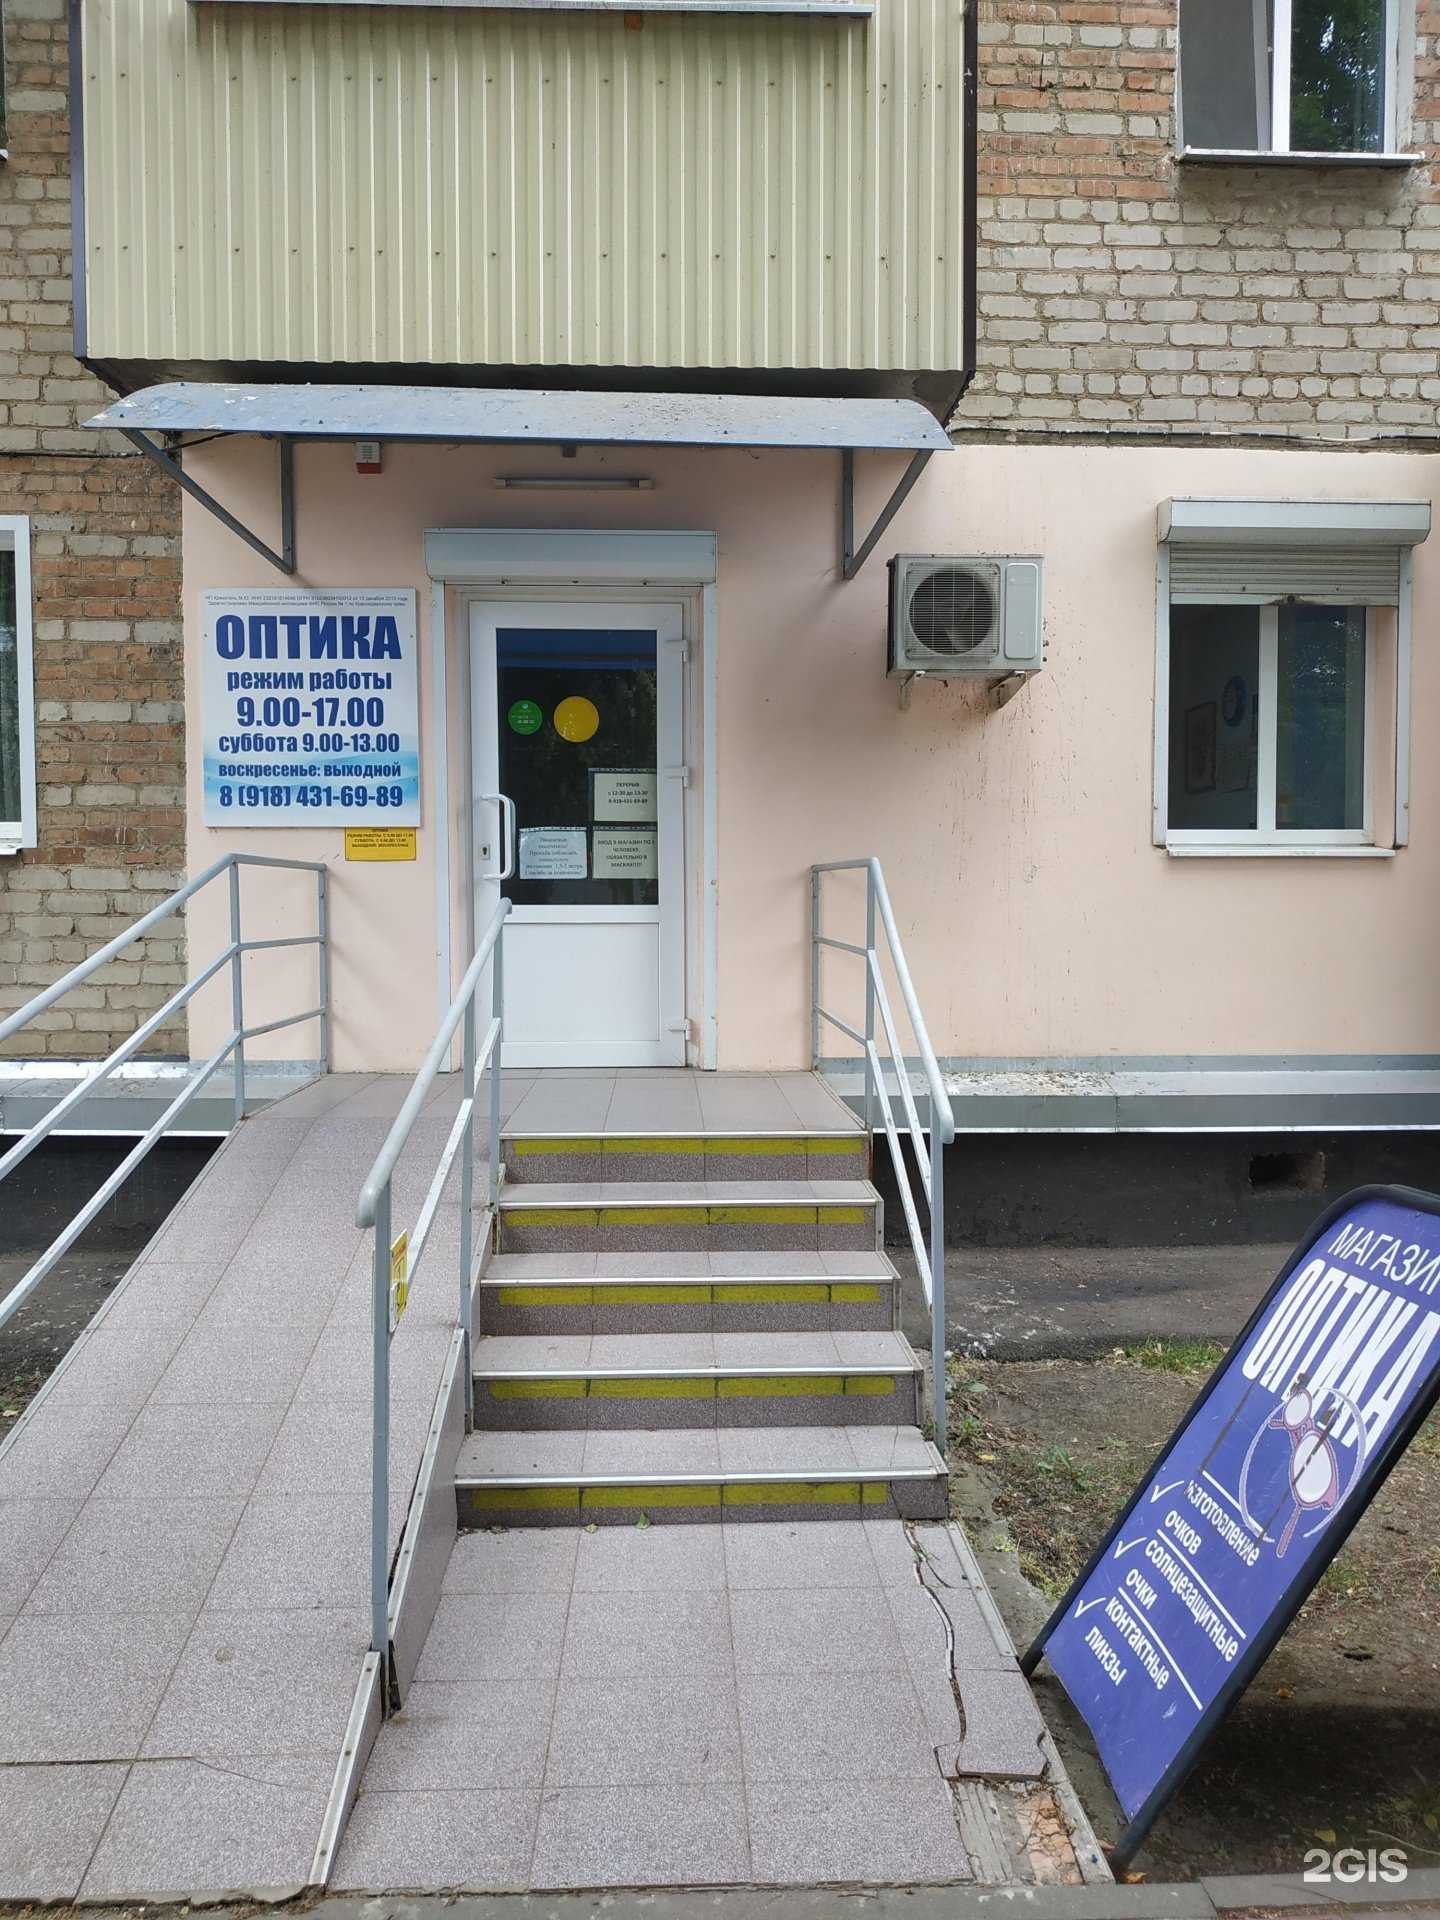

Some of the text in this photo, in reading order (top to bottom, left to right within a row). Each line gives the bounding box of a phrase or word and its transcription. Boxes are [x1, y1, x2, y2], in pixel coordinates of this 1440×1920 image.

[215, 614, 403, 660] ОПТИКА
[227, 669, 392, 692] режим работы
[237, 697, 385, 727] 9.00-17.00
[218, 733, 400, 754] суббота 9.00-13.00
[218, 762, 401, 779] воскресенье: выходной
[219, 785, 403, 807] 8 (918) 431-69-89
[1242, 1258, 1440, 1461] ОПТИКА
[1165, 1510, 1203, 1554] очков
[1184, 1480, 1261, 1567] изготовление
[1126, 1568, 1158, 1610] очки
[1145, 1539, 1239, 1662] солнцезащитные
[1085, 1626, 1127, 1686] линзы
[1105, 1596, 1170, 1690] контактные
